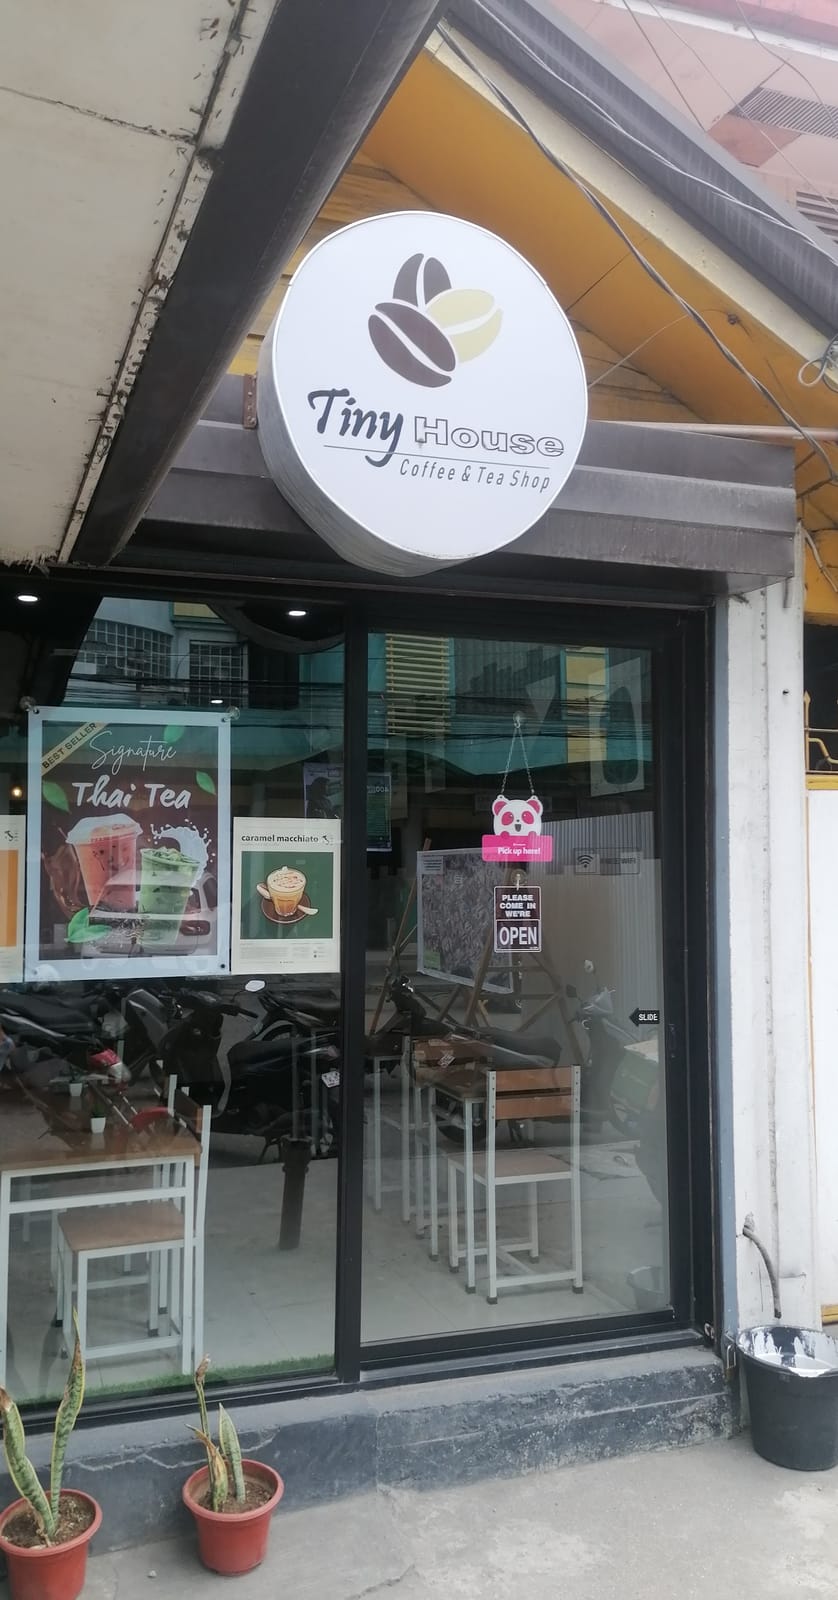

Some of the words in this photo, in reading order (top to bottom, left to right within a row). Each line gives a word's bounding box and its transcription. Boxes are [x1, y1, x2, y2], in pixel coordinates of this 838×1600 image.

[307, 388, 404, 468] Tiny
[414, 415, 564, 457] House
[400, 458, 456, 481] Coffee
[461, 465, 472, 482] &
[477, 466, 504, 486] Tea
[509, 469, 551, 493] Shop
[42, 749, 65, 769] BEST
[65, 722, 97, 751] SELLER
[89, 730, 177, 775] Signature
[71, 774, 137, 807] Thai
[144, 783, 192, 809] Tea
[241, 834, 275, 842] caramel
[276, 834, 319, 843] macchiato
[497, 847, 512, 855] Pick
[523, 847, 541, 855] here!
[502, 894, 534, 902] PLEASE
[499, 902, 524, 910] COME
[526, 902, 537, 910] IN
[505, 910, 531, 918] WE'RE
[499, 926, 538, 946] OPEN
[638, 1013, 659, 1021] SLIDE
